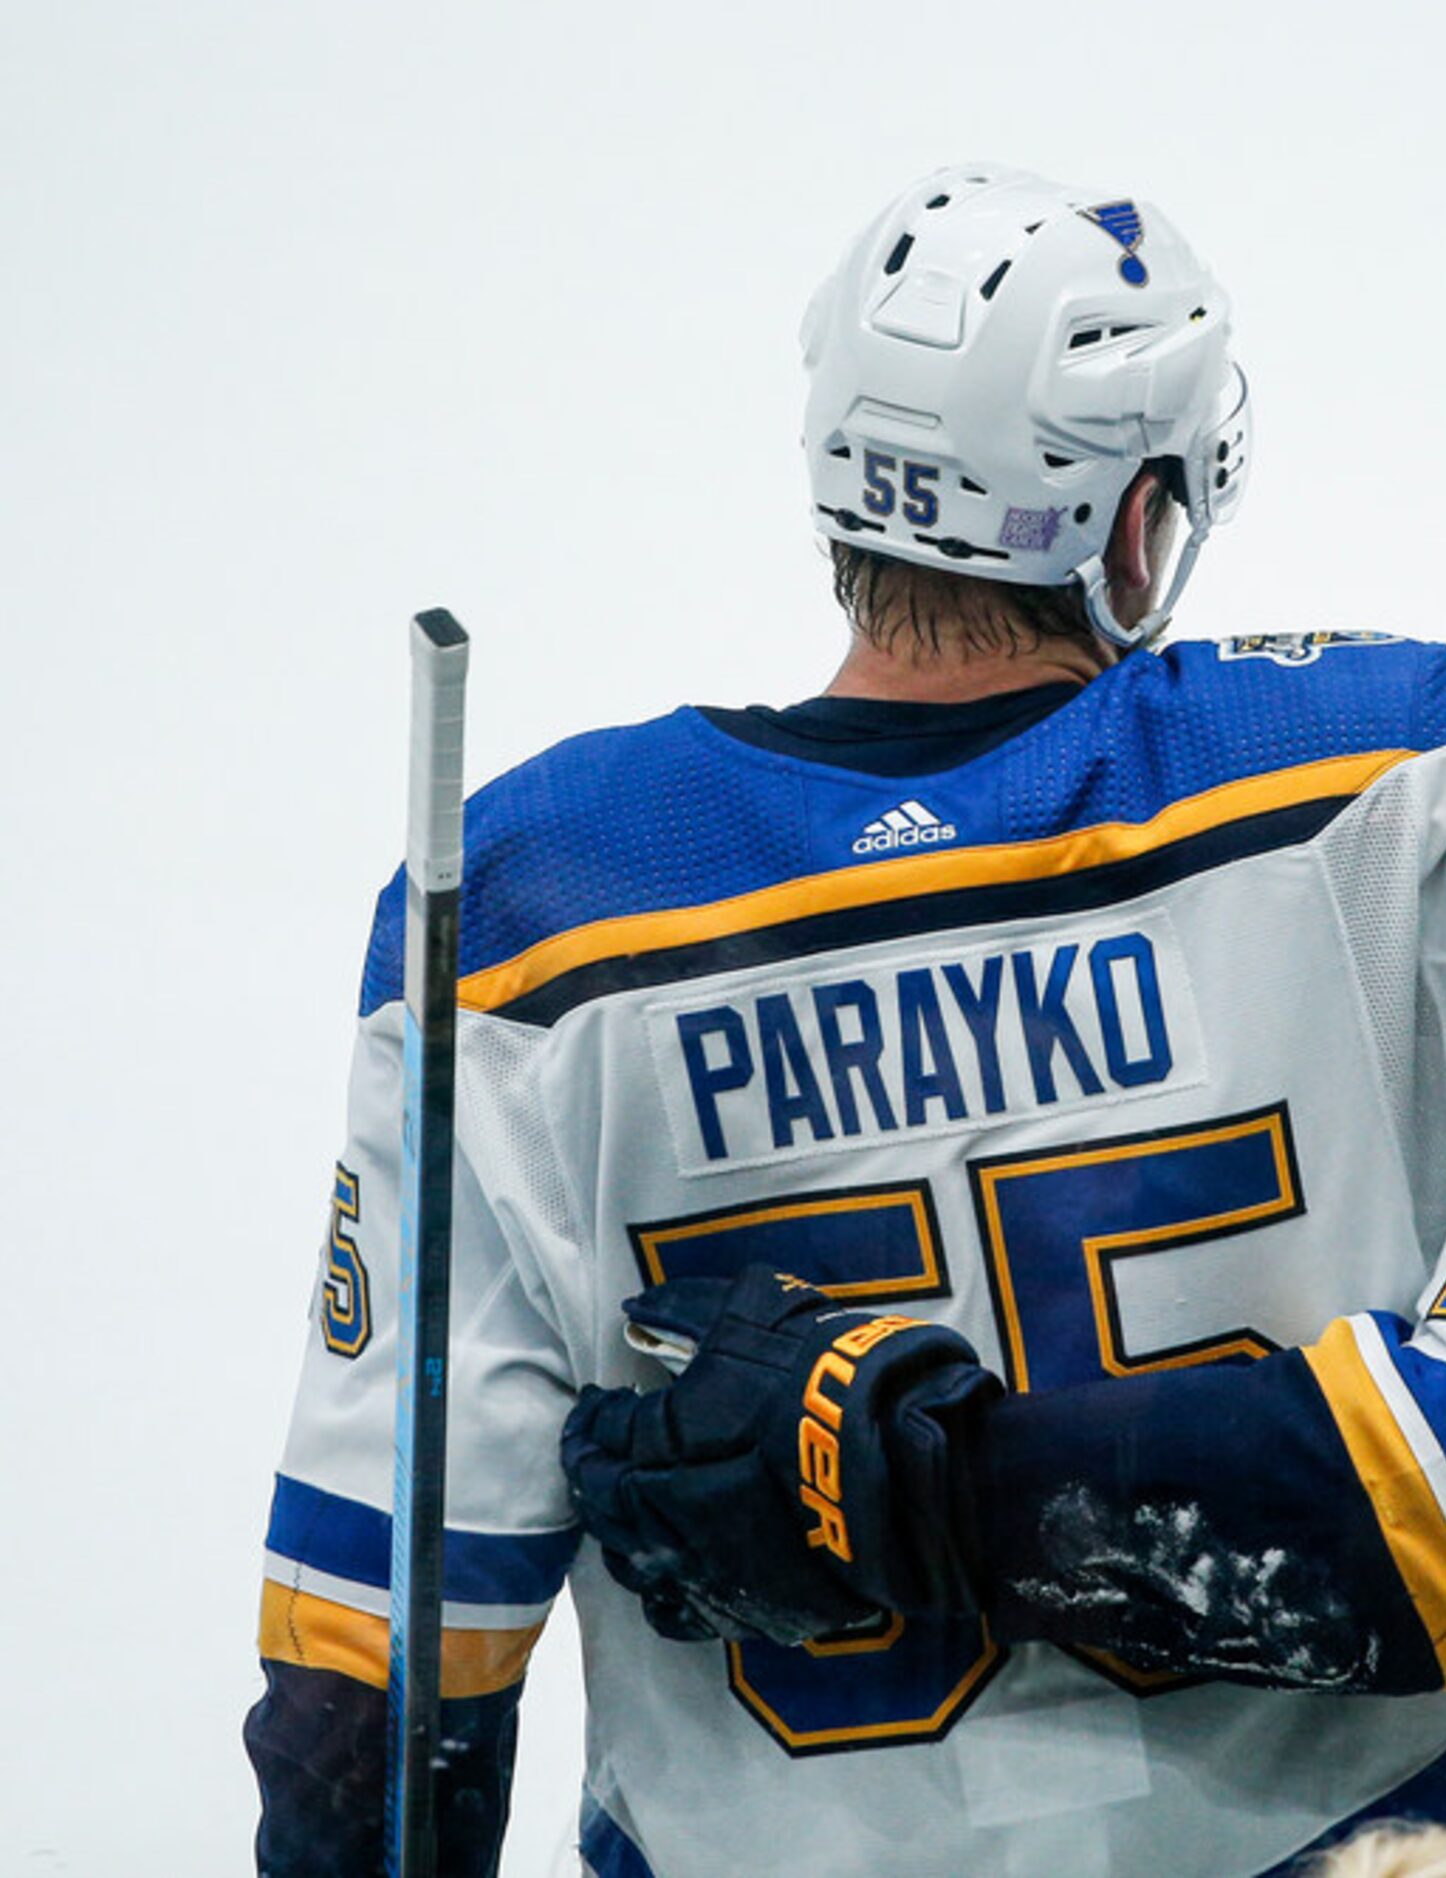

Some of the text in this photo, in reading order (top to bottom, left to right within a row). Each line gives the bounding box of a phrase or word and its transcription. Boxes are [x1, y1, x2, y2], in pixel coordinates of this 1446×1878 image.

[862, 447, 940, 529] 55
[852, 824, 957, 854] adidas
[675, 932, 1174, 1160] PARAYKO
[799, 1314, 932, 1563] BAUER
